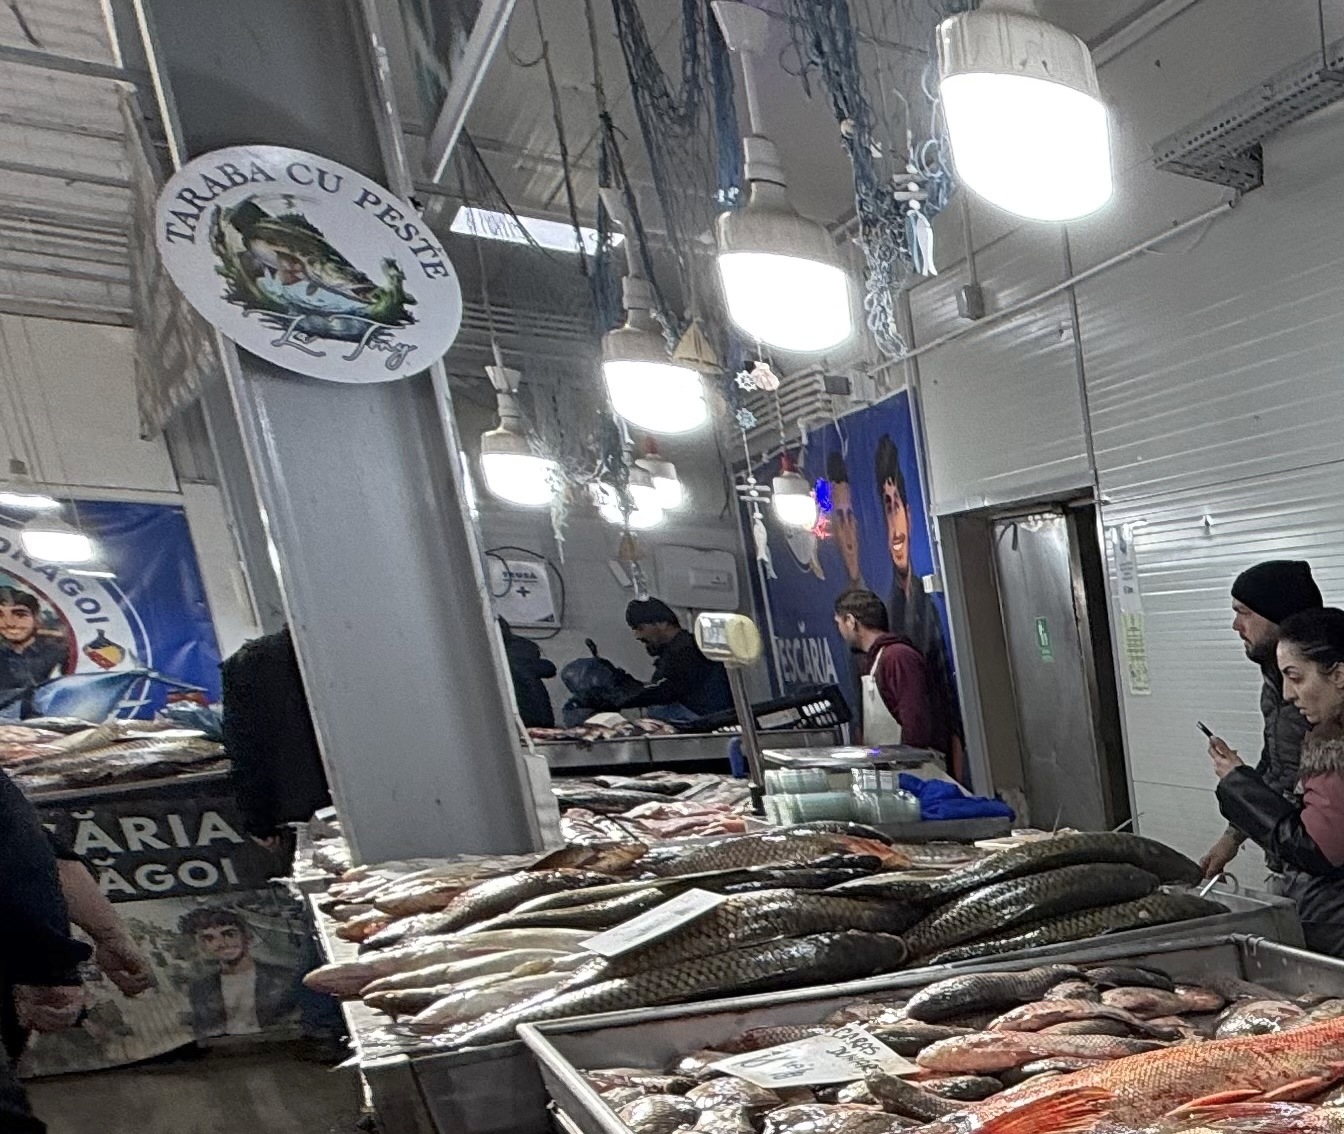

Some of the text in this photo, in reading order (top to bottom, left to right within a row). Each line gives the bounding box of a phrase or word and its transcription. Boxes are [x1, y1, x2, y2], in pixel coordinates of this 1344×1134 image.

[166, 161, 276, 245] TARABA
[286, 162, 344, 194] CU
[41, 810, 244, 855] ĂRIA
[93, 855, 239, 892] ĂGOI
